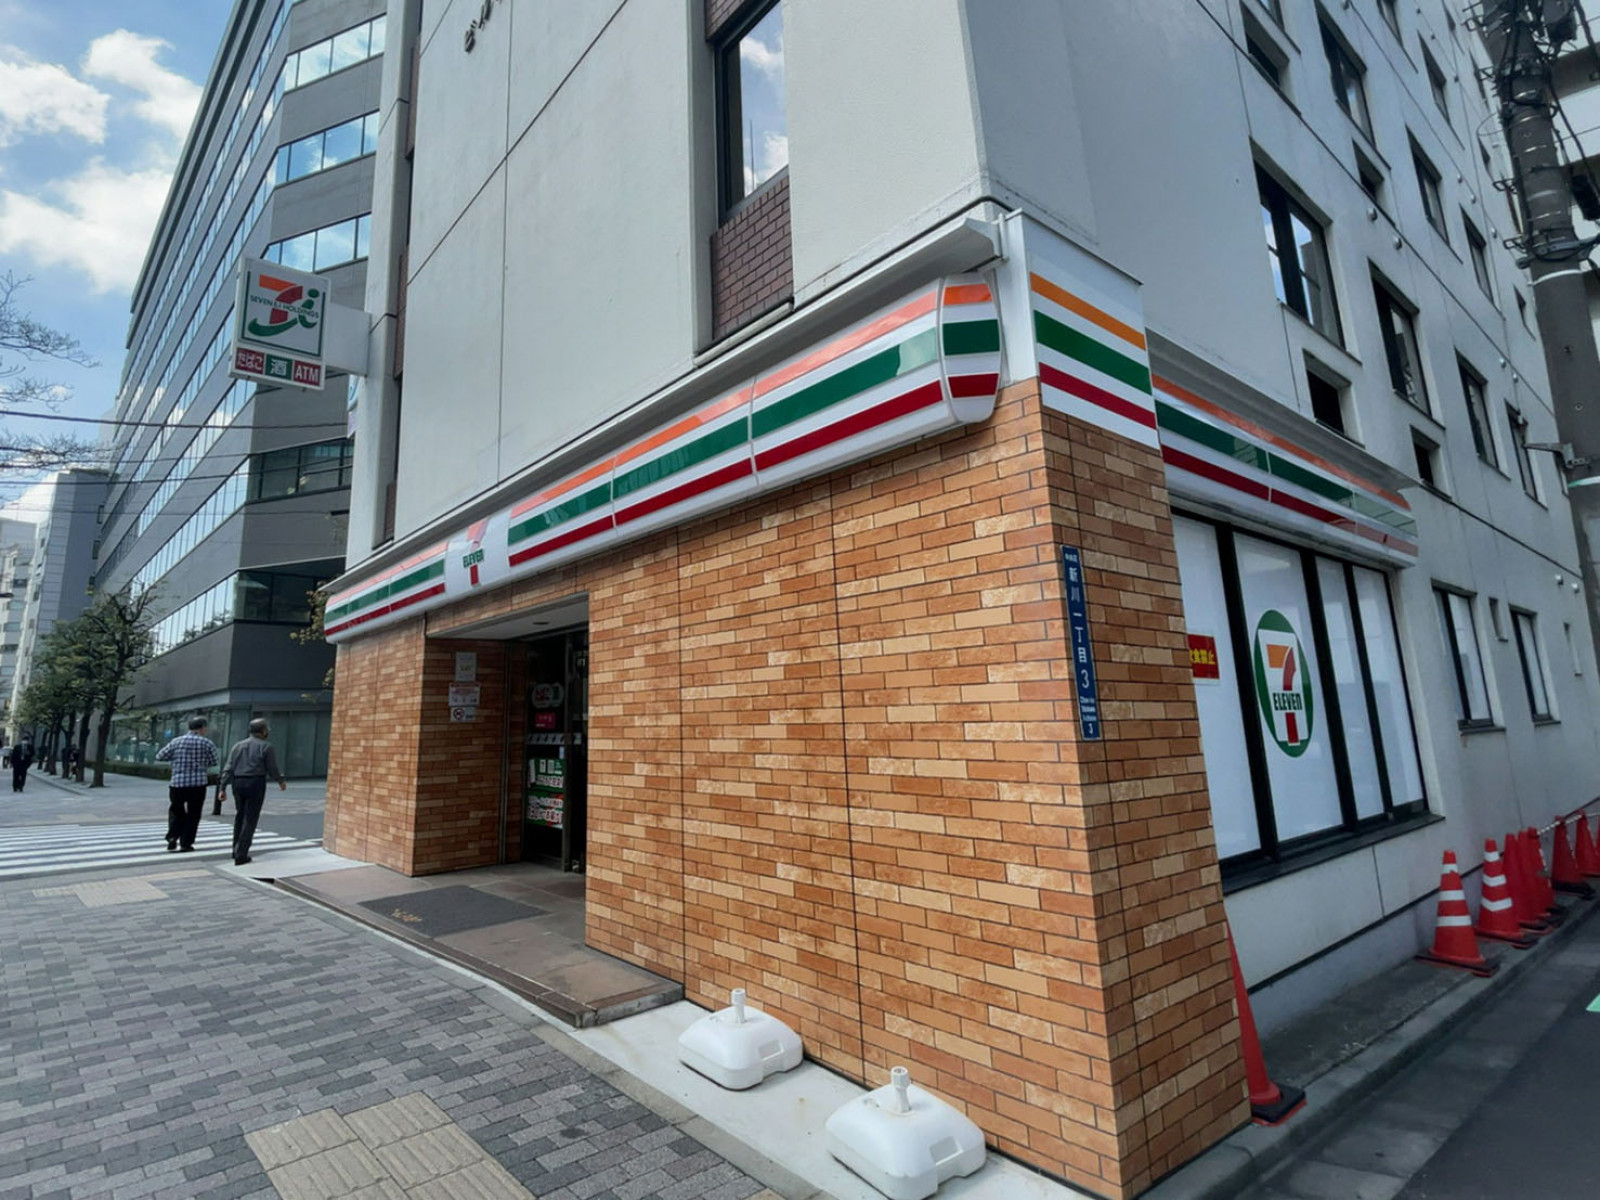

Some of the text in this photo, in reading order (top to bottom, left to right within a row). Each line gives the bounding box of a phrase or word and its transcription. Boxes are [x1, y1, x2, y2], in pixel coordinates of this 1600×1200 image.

[250, 295, 273, 307] SEVEN
[282, 303, 320, 319] HOLDINGS
[237, 349, 320, 382] たばこ 酒 ATM
